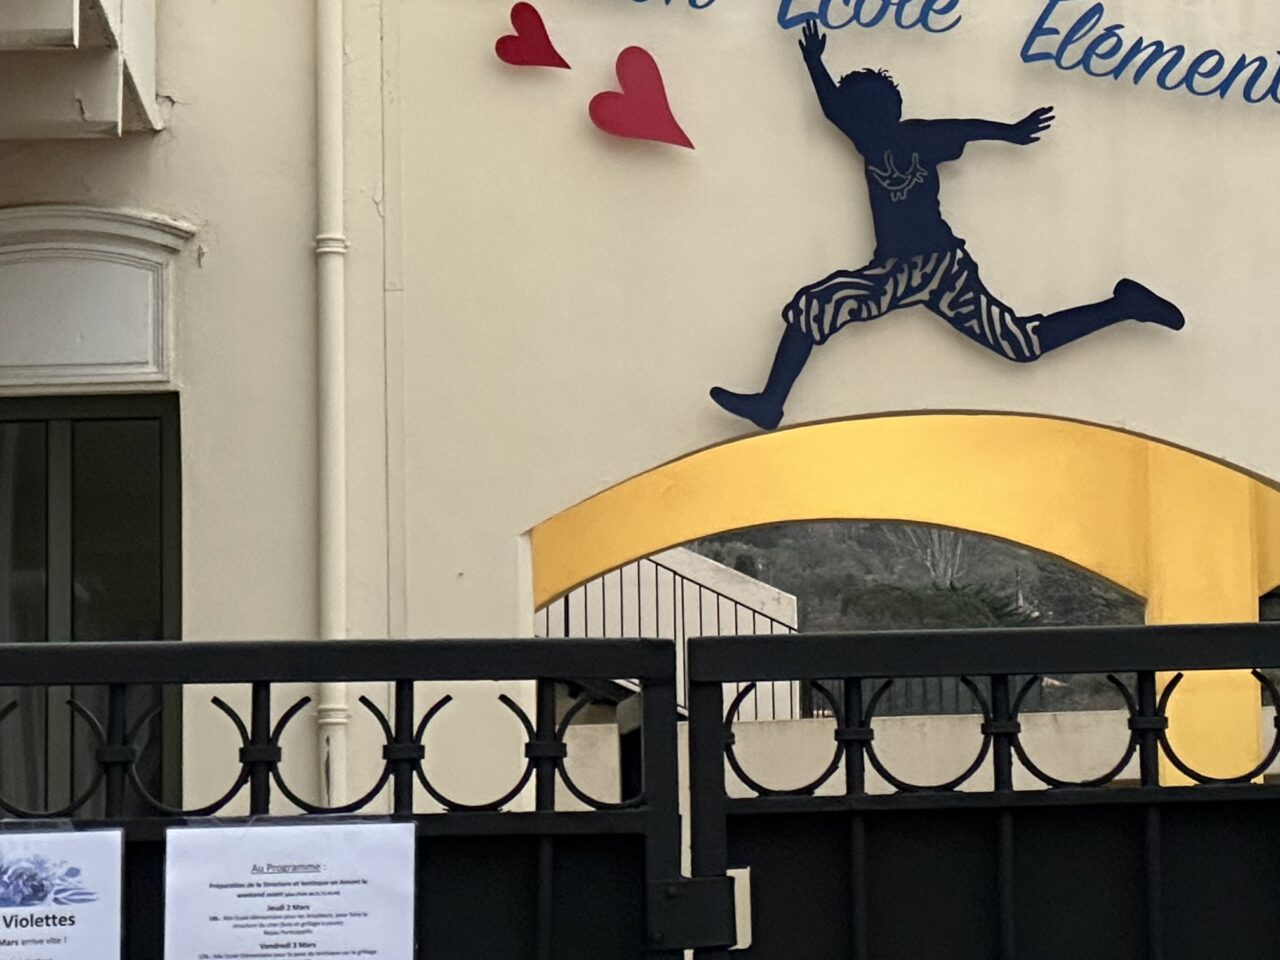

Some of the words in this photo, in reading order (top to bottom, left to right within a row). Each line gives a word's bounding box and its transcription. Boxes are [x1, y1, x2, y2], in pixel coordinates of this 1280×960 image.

[251, 863, 264, 874] Au
[266, 863, 322, 874] Programme
[2, 913, 76, 929] Violettes
